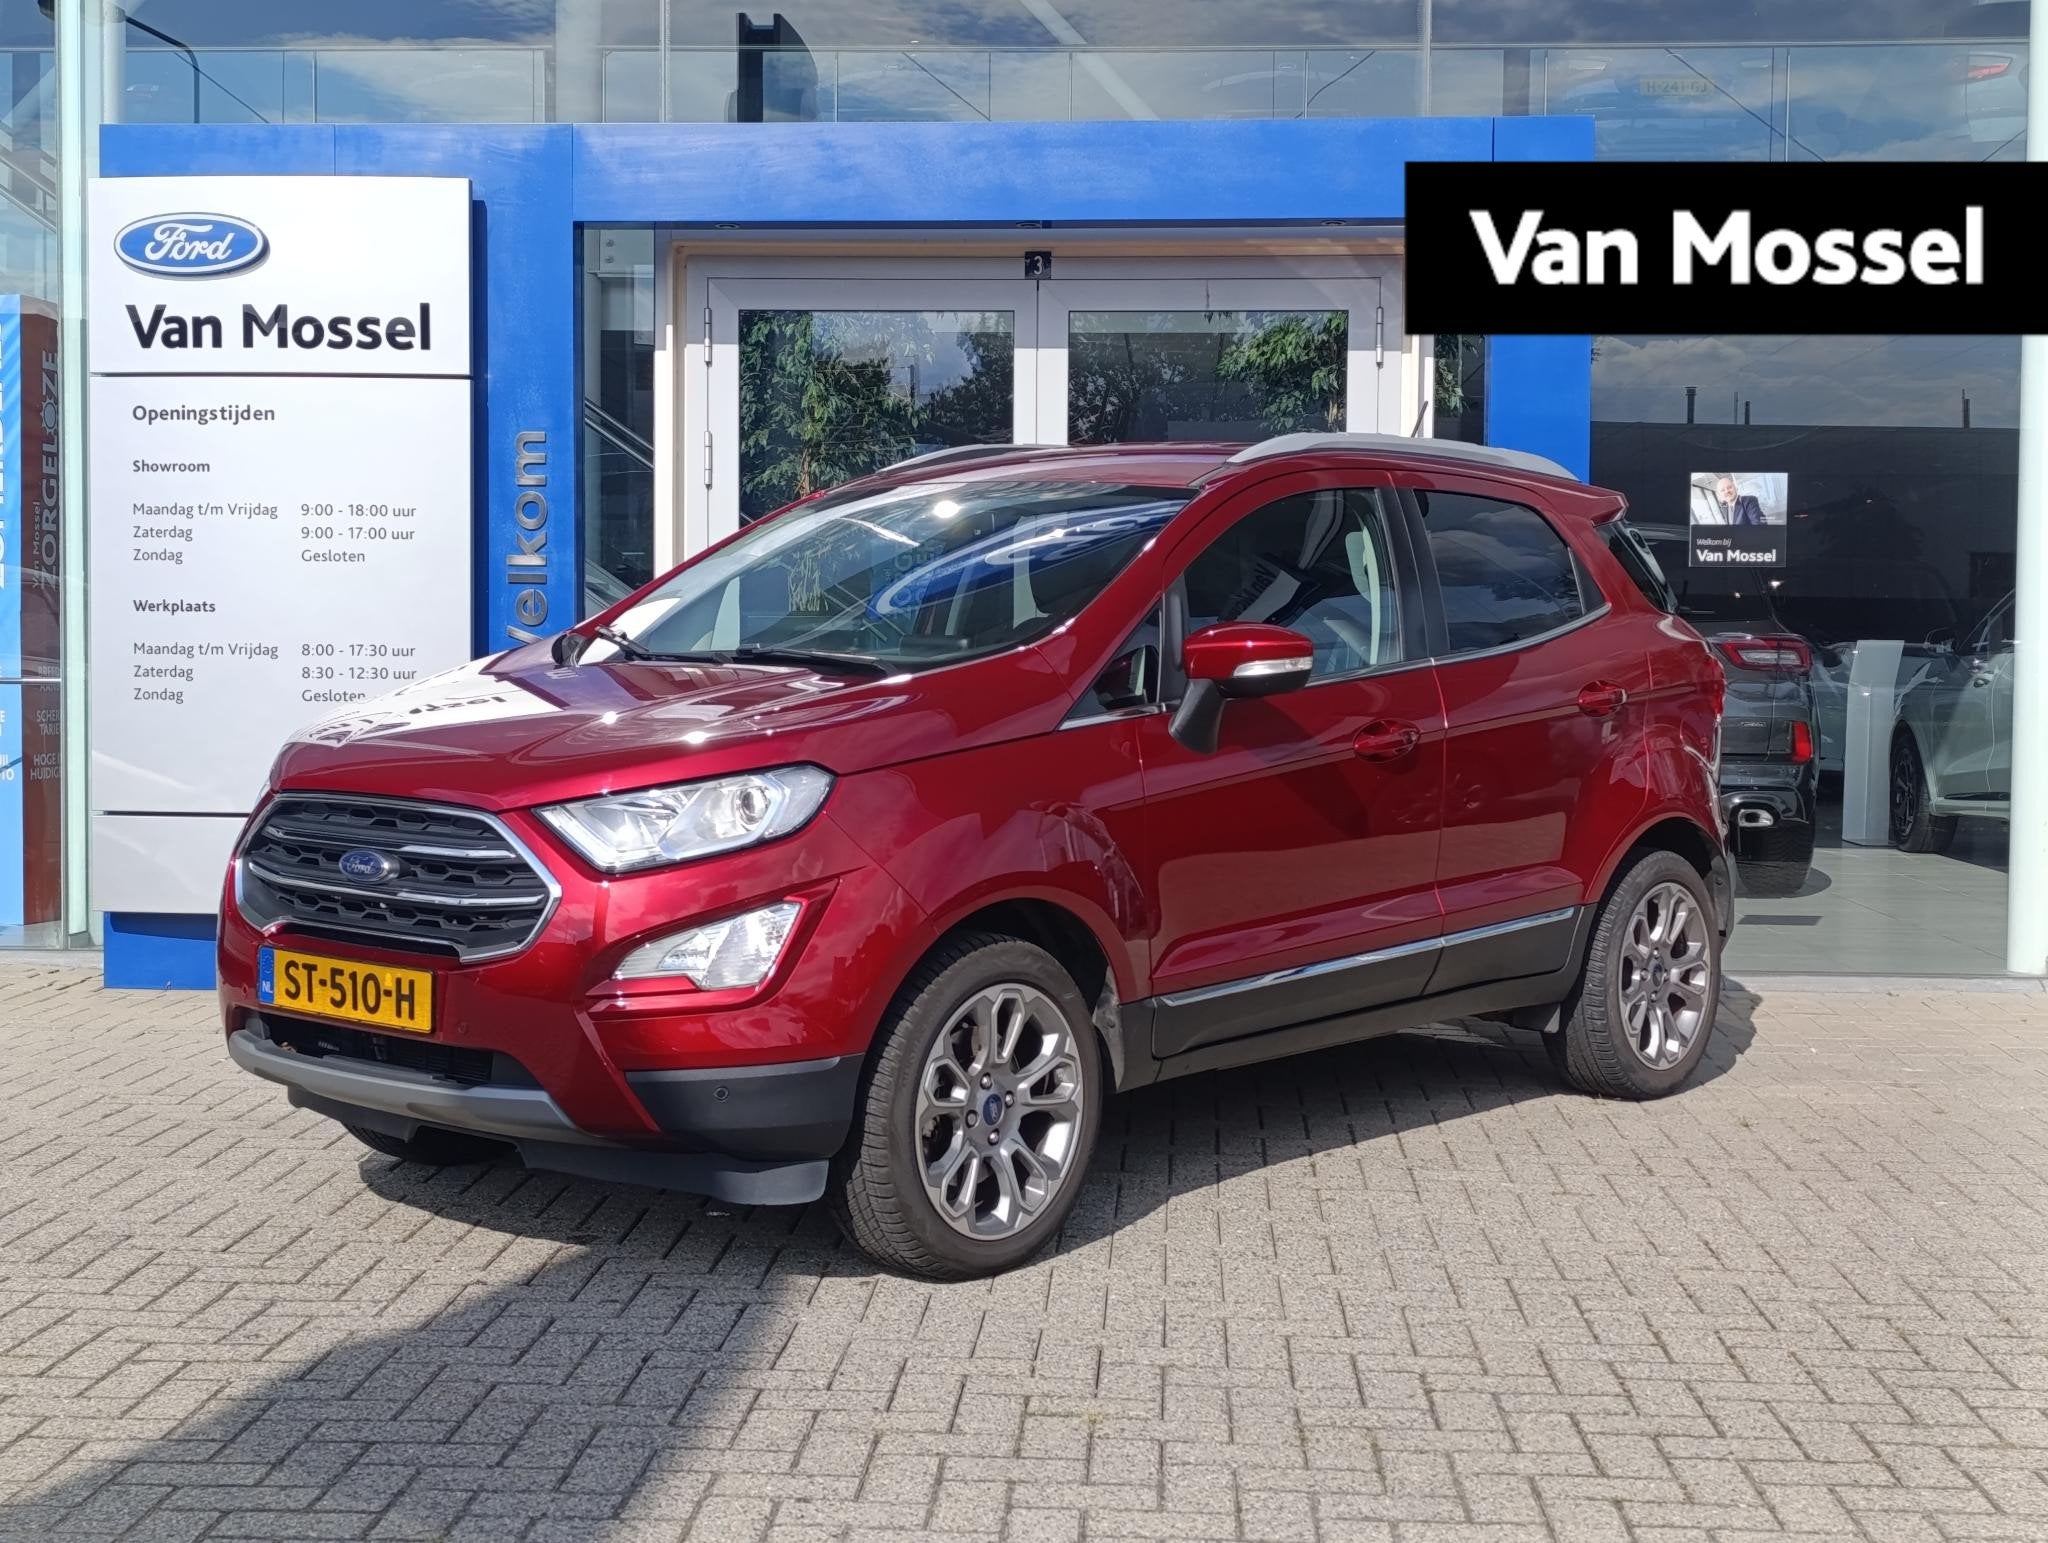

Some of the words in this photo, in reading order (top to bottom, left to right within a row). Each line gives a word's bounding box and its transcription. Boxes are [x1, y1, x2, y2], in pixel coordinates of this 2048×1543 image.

[145, 223, 235, 260] Ford
[1034, 255, 1043, 275] 3
[126, 304, 223, 349] Van
[242, 303, 430, 350] Mossel
[132, 404, 275, 426] Openingstijden
[132, 459, 210, 473] Showroom
[132, 503, 193, 519] Maandag
[197, 503, 223, 517] t/m
[227, 503, 278, 520] Vrijdag
[301, 504, 333, 517] 9:00
[347, 504, 388, 517] 18:00
[393, 507, 416, 517] uur
[32, 501, 41, 555] Mossel
[132, 525, 193, 542] Zaterdag
[301, 527, 333, 540] 9:00
[348, 527, 387, 540] 17:00
[391, 530, 415, 540] uur
[506, 431, 548, 645] elkom
[1696, 538, 1722, 546] Welkom
[1722, 538, 1732, 547] bij
[132, 548, 183, 565] Zondag
[301, 549, 366, 563] Gesloten
[1696, 549, 1724, 562] Van
[1726, 548, 1777, 562] Mossel
[132, 599, 216, 615] Werkplaats
[133, 642, 194, 658] Maandag
[198, 642, 224, 656] t/m
[228, 642, 279, 660] Vrijdag
[301, 644, 334, 657] 8:00
[348, 644, 387, 657] 17:30
[392, 647, 416, 657] uur
[133, 664, 194, 681] Zaterdag
[301, 666, 334, 680] 8:30
[348, 666, 388, 680] 12:30
[392, 669, 417, 680] uur
[133, 688, 184, 705] Zondag
[33, 753, 57, 766] HOGE
[347, 855, 376, 873] Ford
[262, 981, 273, 994] NL
[284, 960, 416, 1021] ST-510-H
